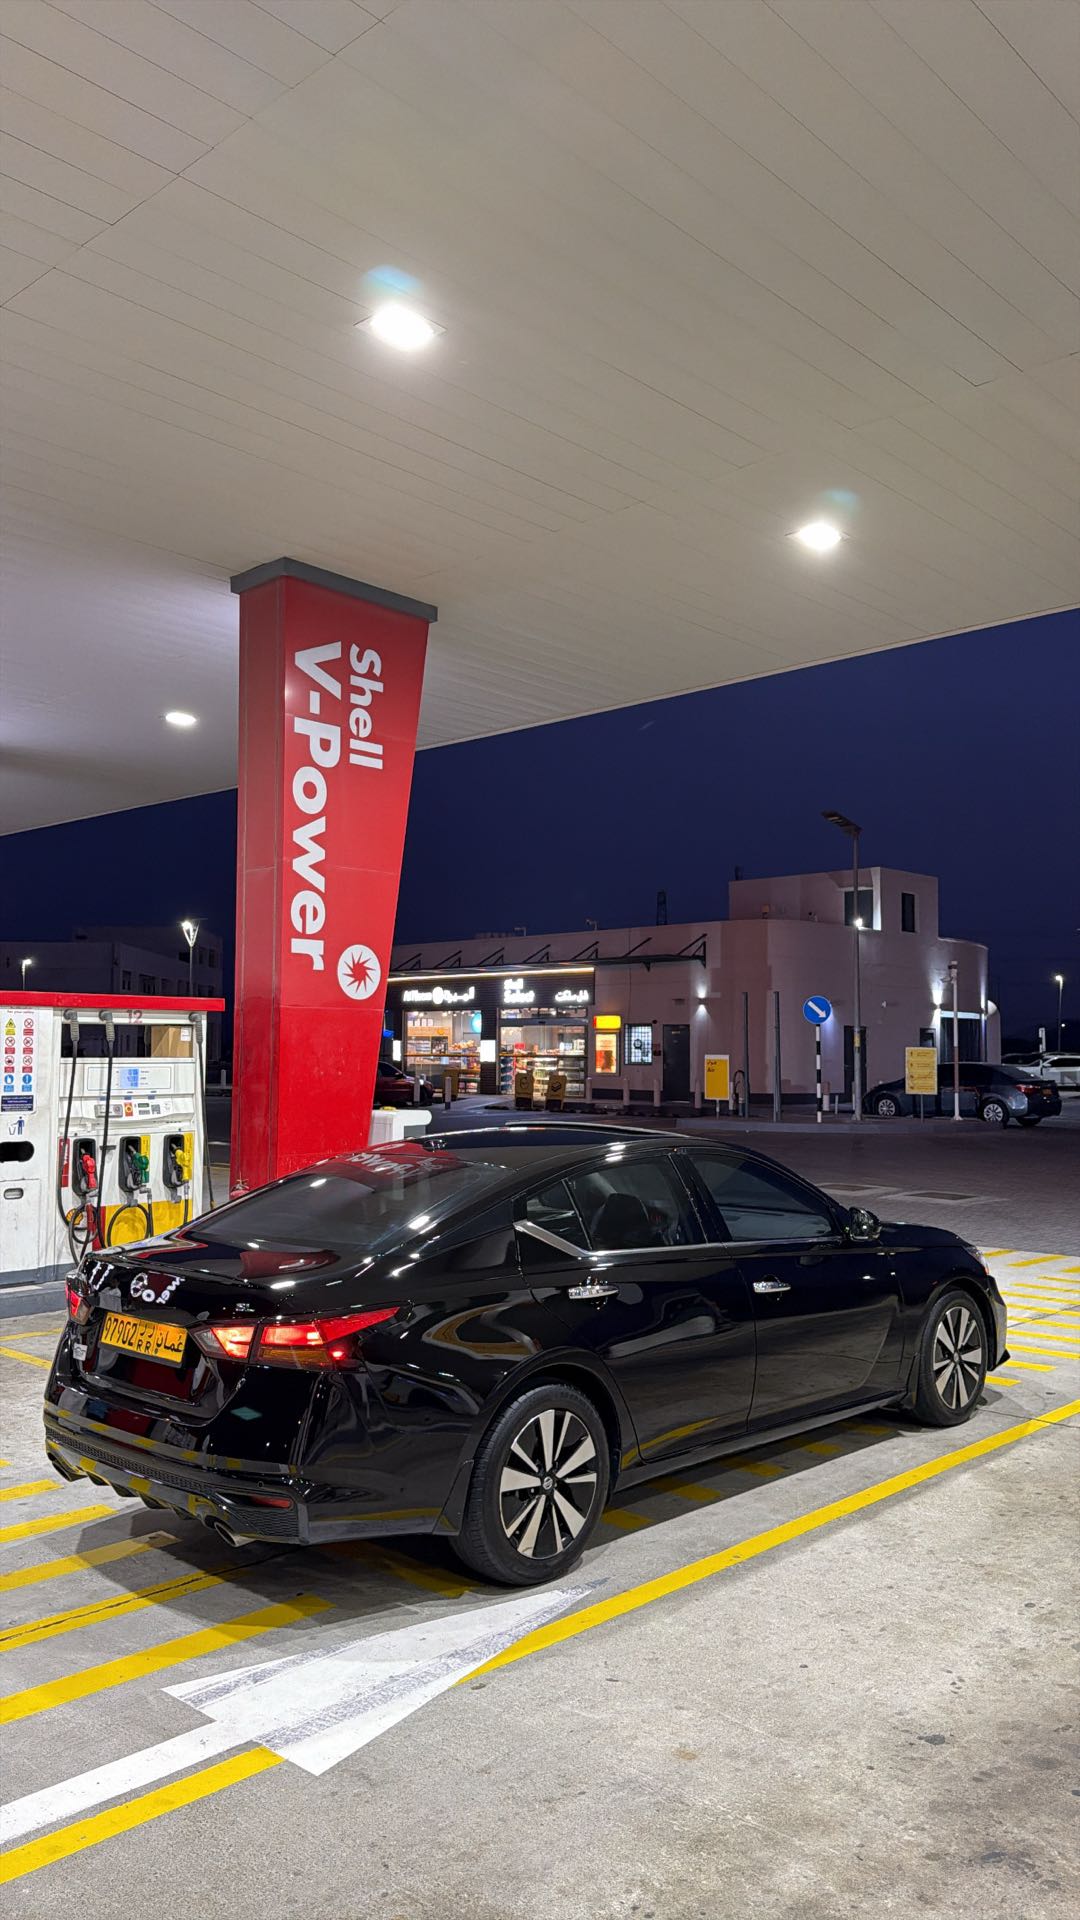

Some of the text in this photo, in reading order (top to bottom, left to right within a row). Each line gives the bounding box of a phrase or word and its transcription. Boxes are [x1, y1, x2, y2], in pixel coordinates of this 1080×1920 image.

[350, 643, 384, 770] Shell
[290, 640, 342, 971] V-Power
[504, 989, 535, 1003] Select
[127, 1010, 143, 1024] 12
[104, 1317, 137, 1347] 97902
